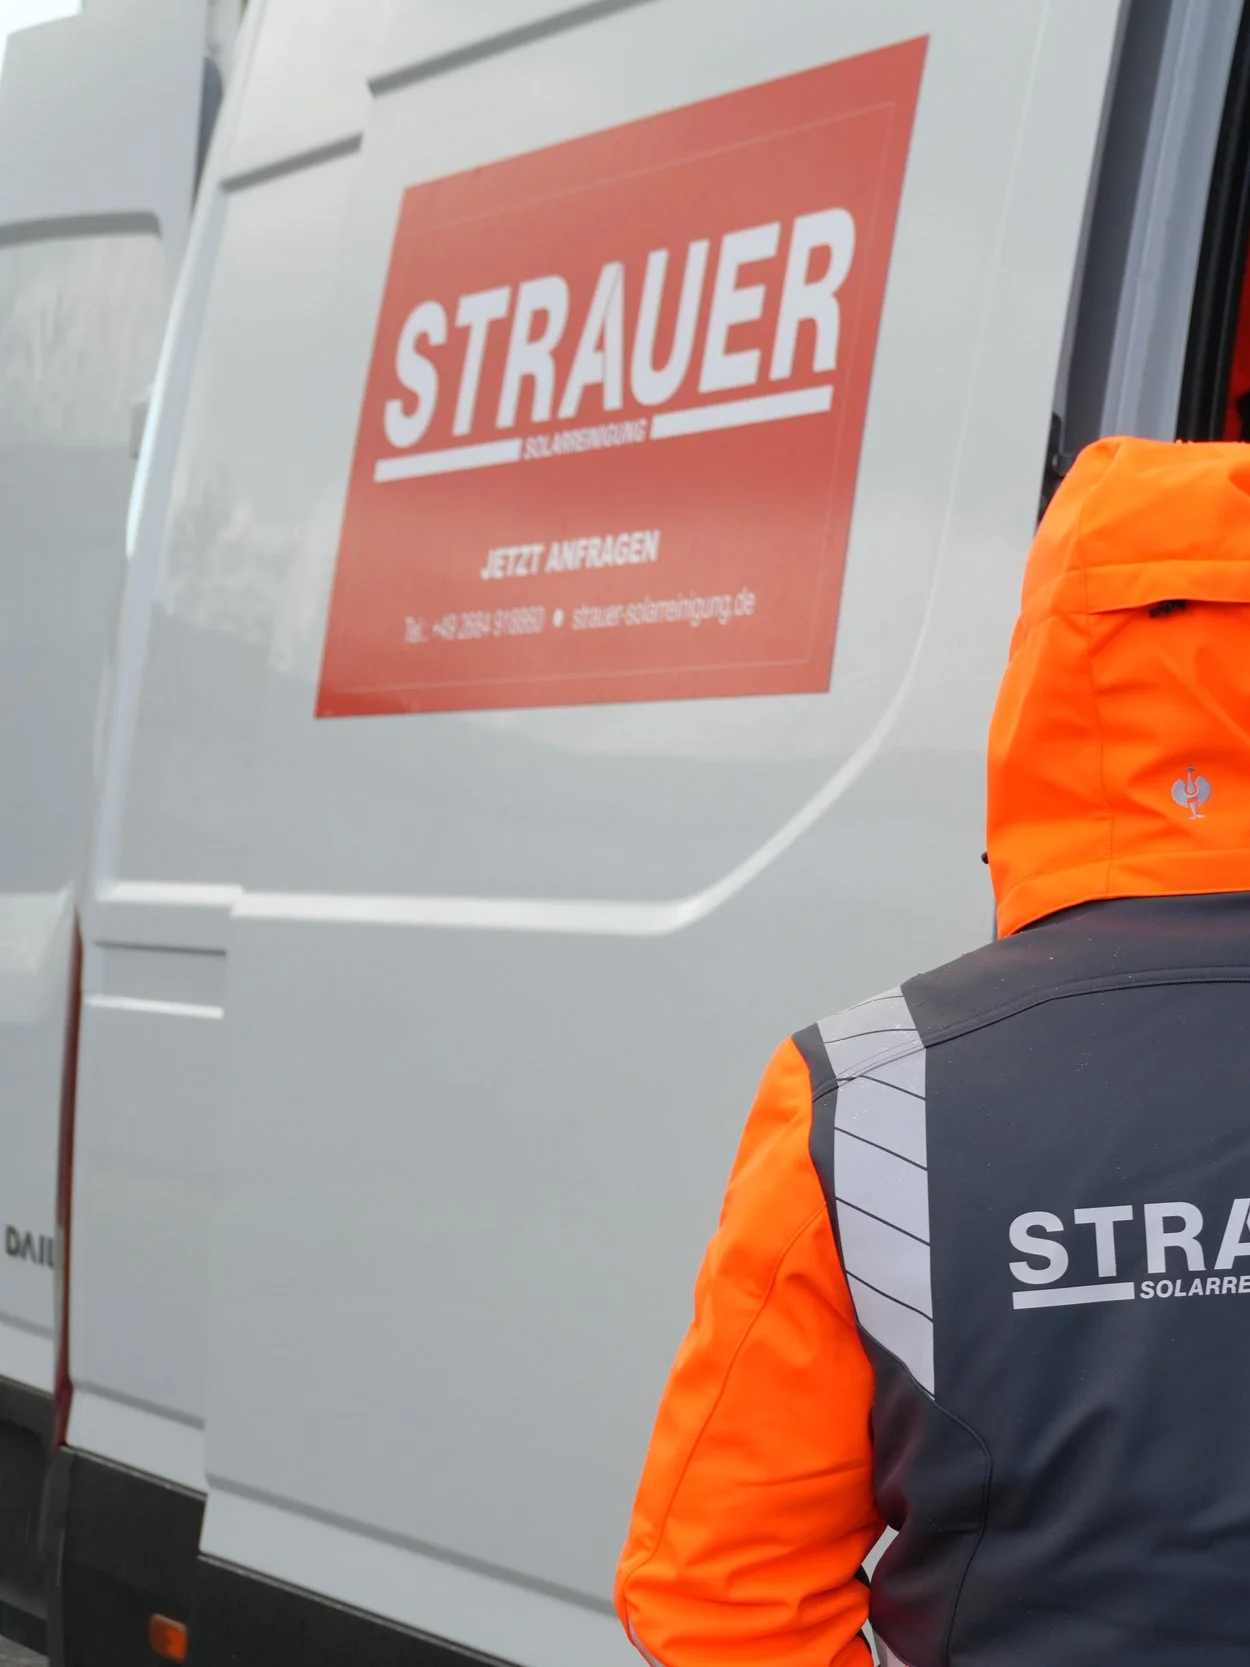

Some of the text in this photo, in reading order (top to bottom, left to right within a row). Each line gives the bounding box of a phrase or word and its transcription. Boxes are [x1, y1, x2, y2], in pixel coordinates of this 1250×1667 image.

[382, 206, 857, 449] STRAUER
[524, 417, 648, 461] SOLARREINIGUNG
[480, 528, 662, 581] JETZT ANFRAGEN
